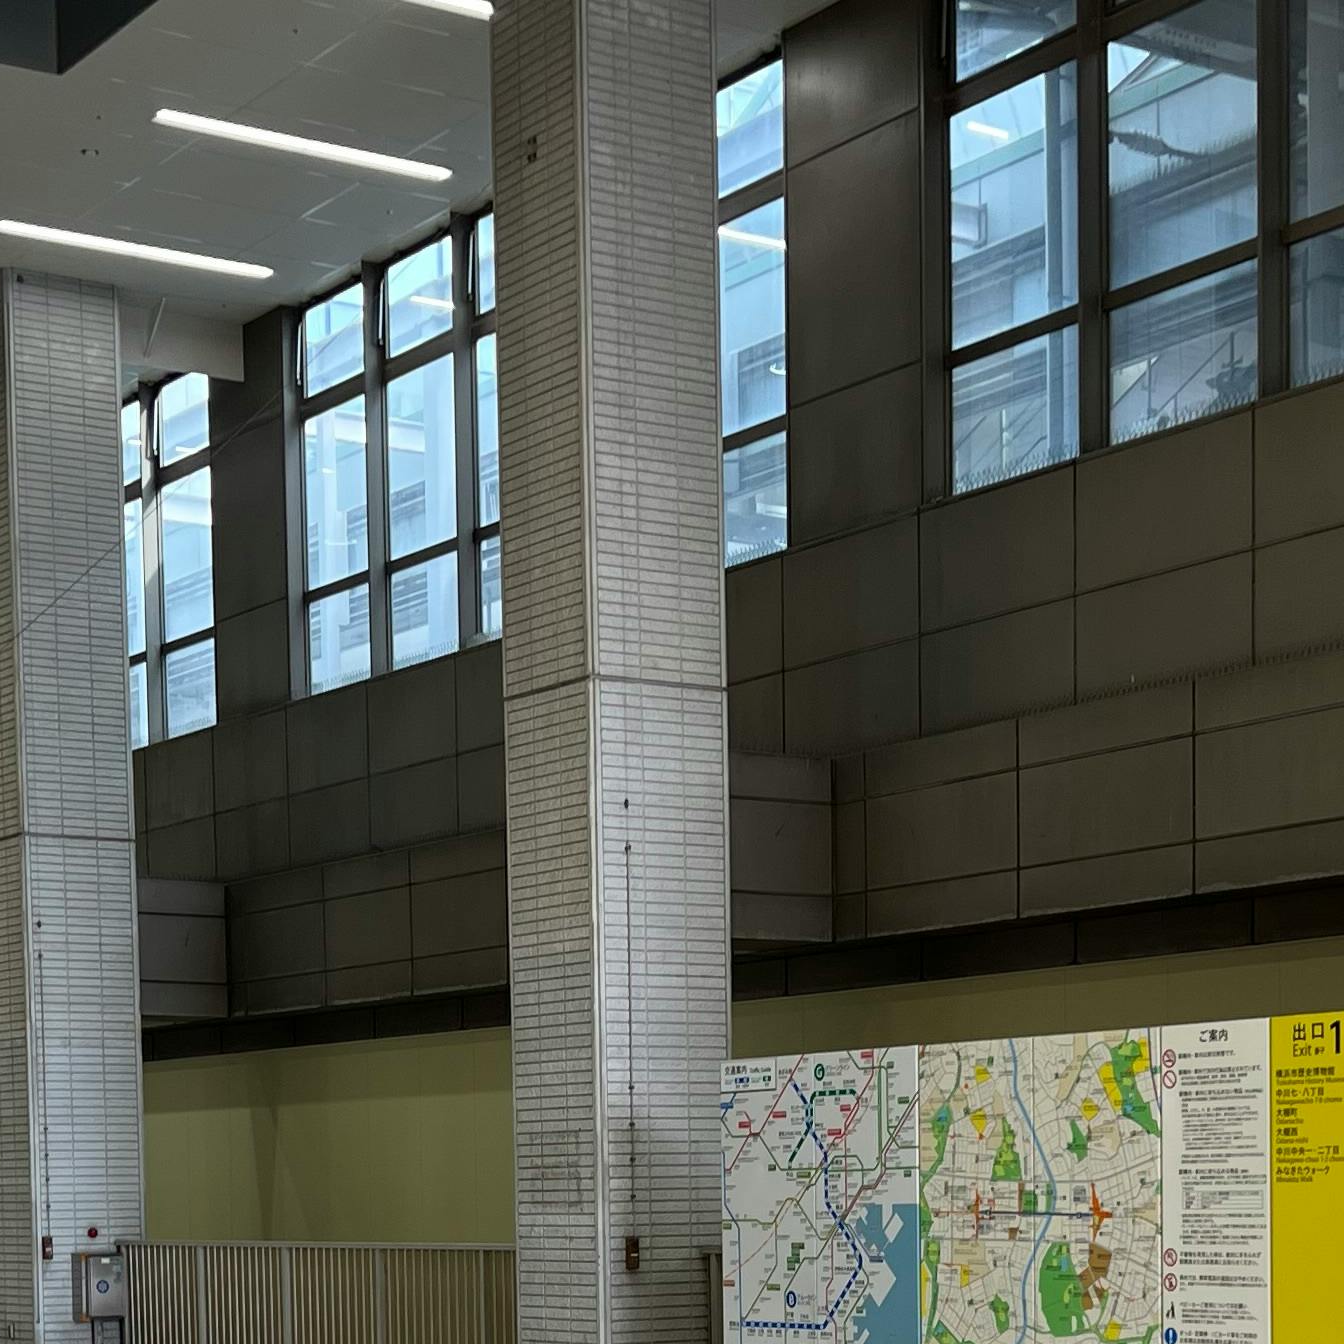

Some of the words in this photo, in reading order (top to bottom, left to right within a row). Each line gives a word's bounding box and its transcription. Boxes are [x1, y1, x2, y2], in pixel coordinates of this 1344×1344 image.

[1200, 1029, 1228, 1042] ご案内
[1293, 1023, 1324, 1041] 出口
[1329, 1020, 1340, 1054] 1
[1293, 1044, 1311, 1057] Exit
